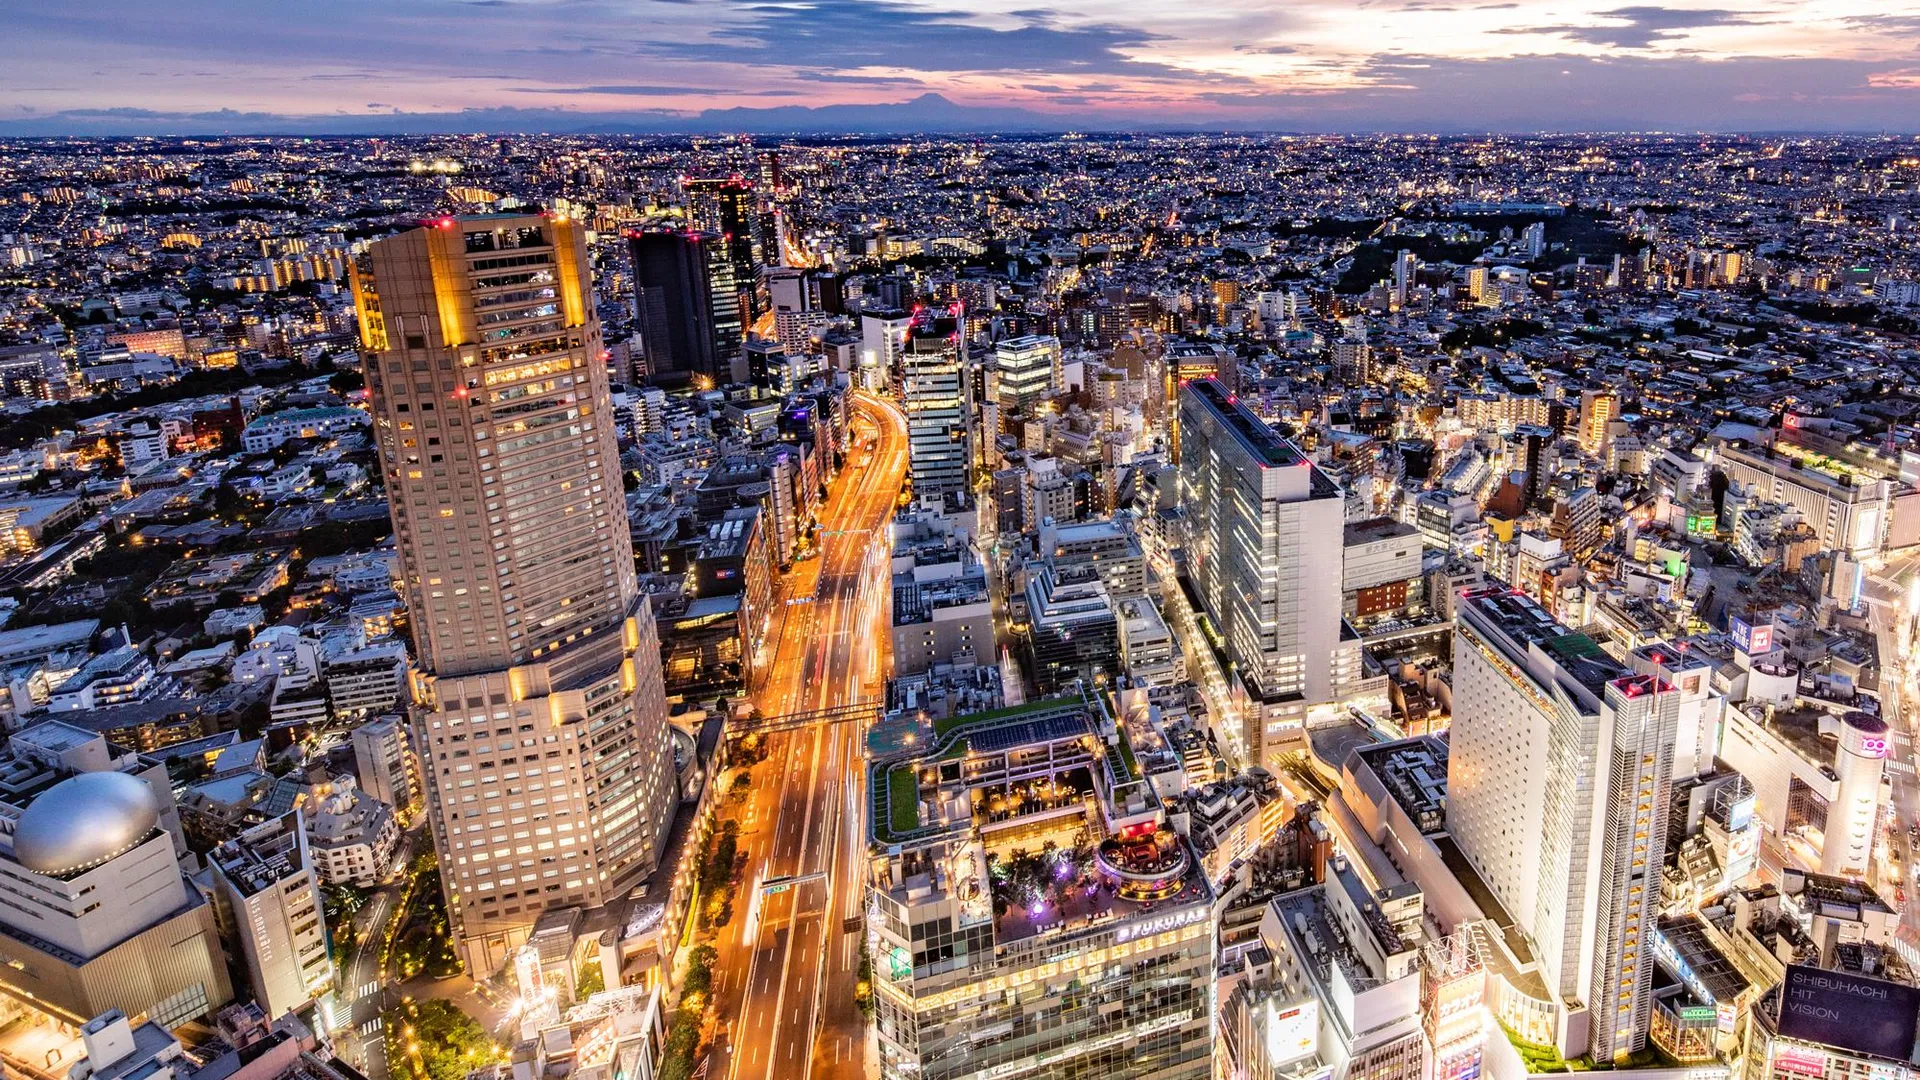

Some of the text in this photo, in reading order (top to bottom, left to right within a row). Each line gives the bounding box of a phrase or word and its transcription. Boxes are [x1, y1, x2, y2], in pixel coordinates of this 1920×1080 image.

[1737, 622, 1748, 638] THE
[1731, 630, 1750, 650] PRIME
[1862, 738, 1888, 756] 109
[1790, 987, 1816, 1000] HIT
[1793, 972, 1888, 1000] SHIBUHACHI
[1789, 1001, 1840, 1020] VISION
